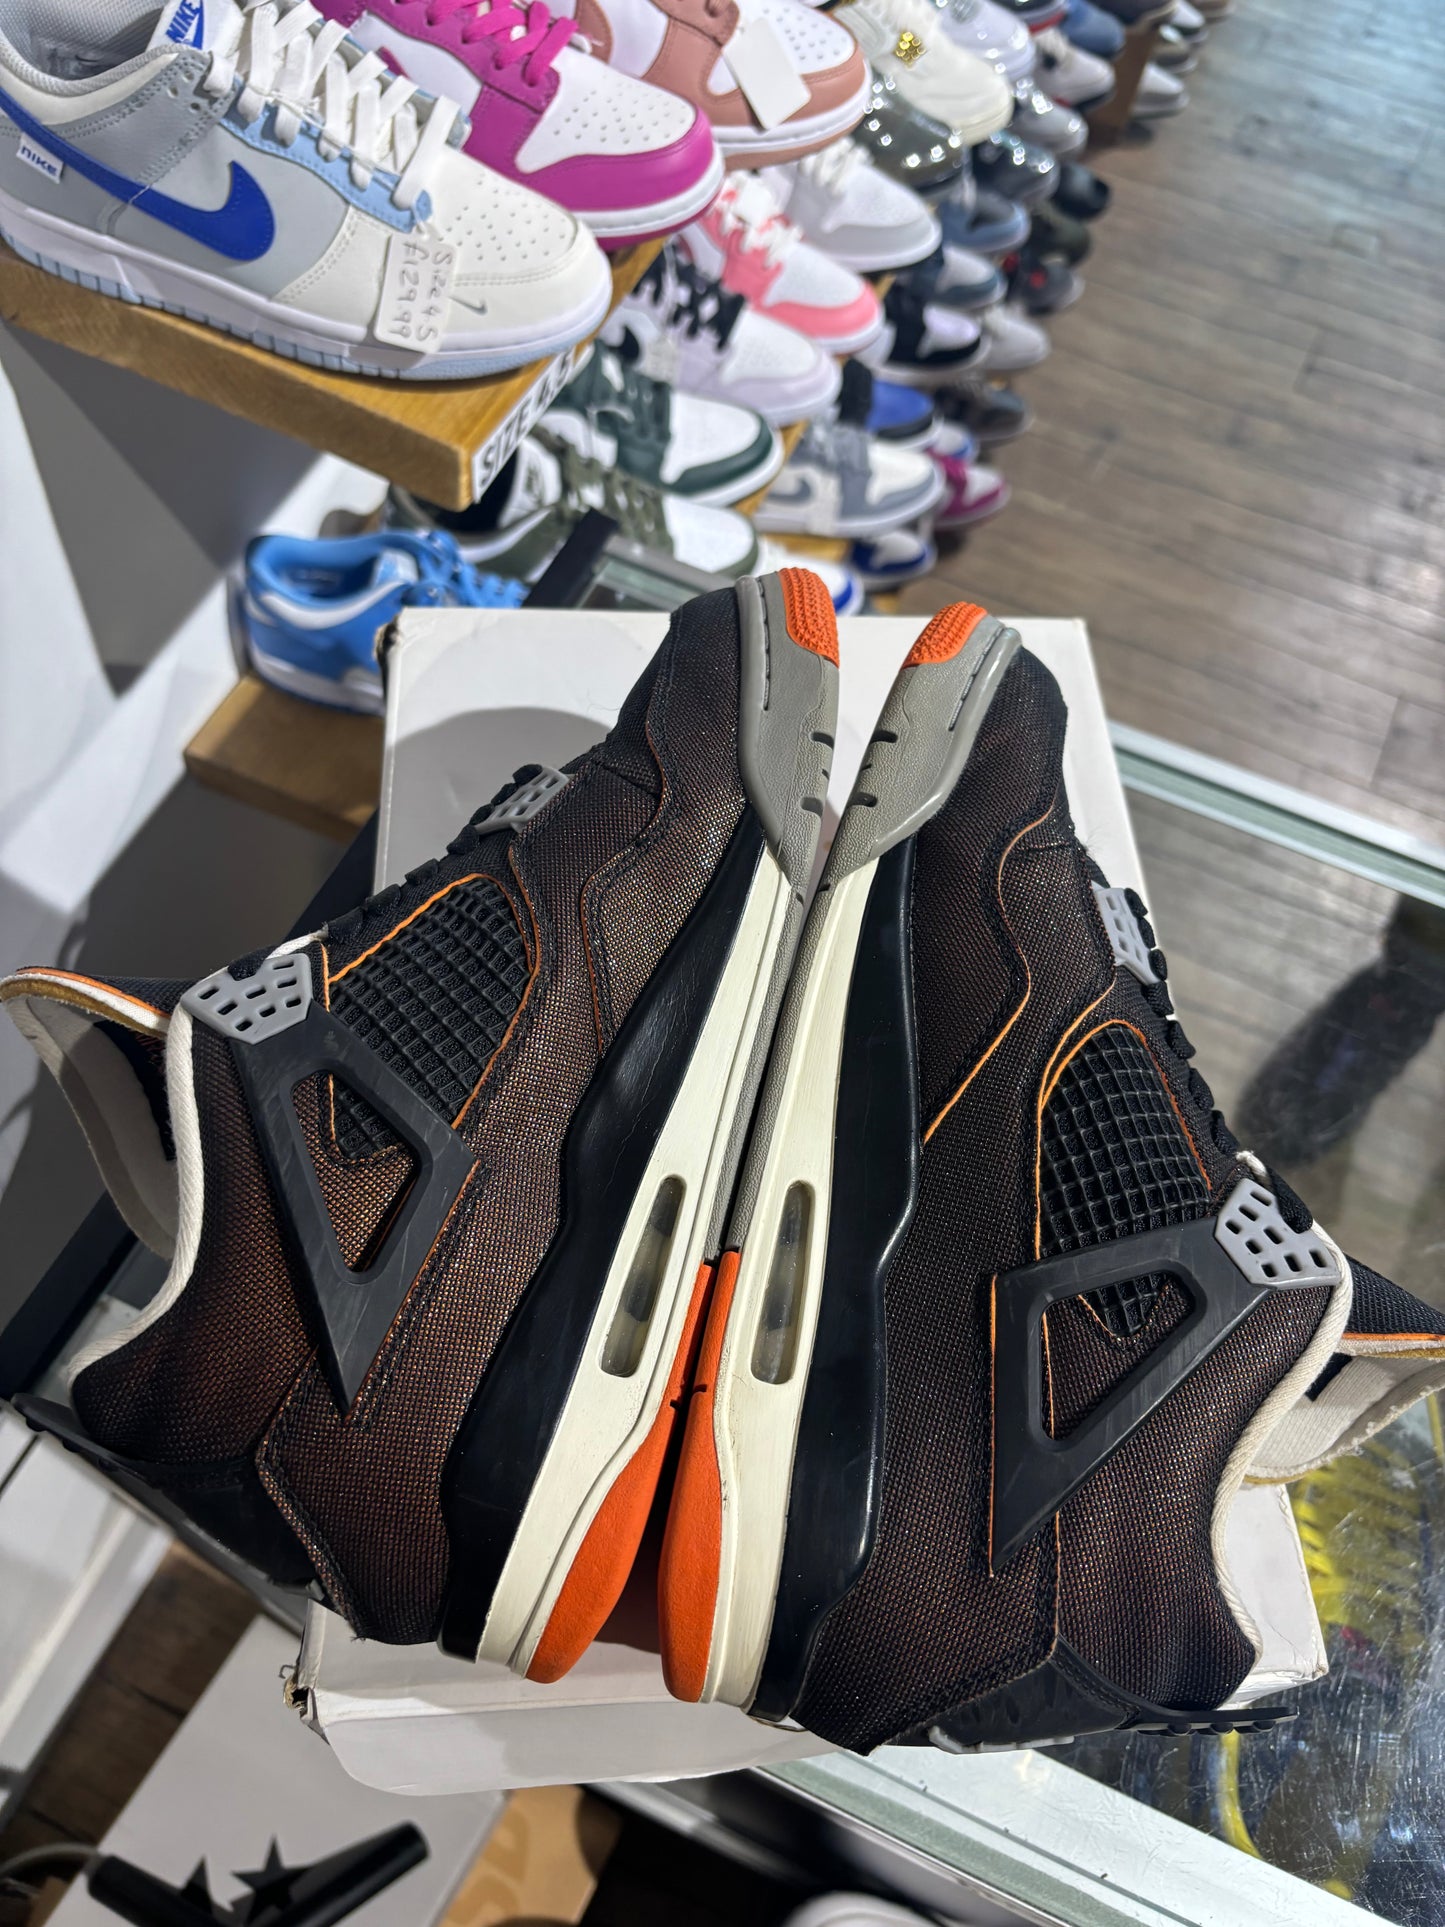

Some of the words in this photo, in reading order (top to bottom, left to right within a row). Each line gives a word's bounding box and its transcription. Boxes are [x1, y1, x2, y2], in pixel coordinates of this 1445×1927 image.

[166, 0, 199, 43] NIKE
[428, 250, 454, 300] Size
[479, 396, 531, 487] SIZE
